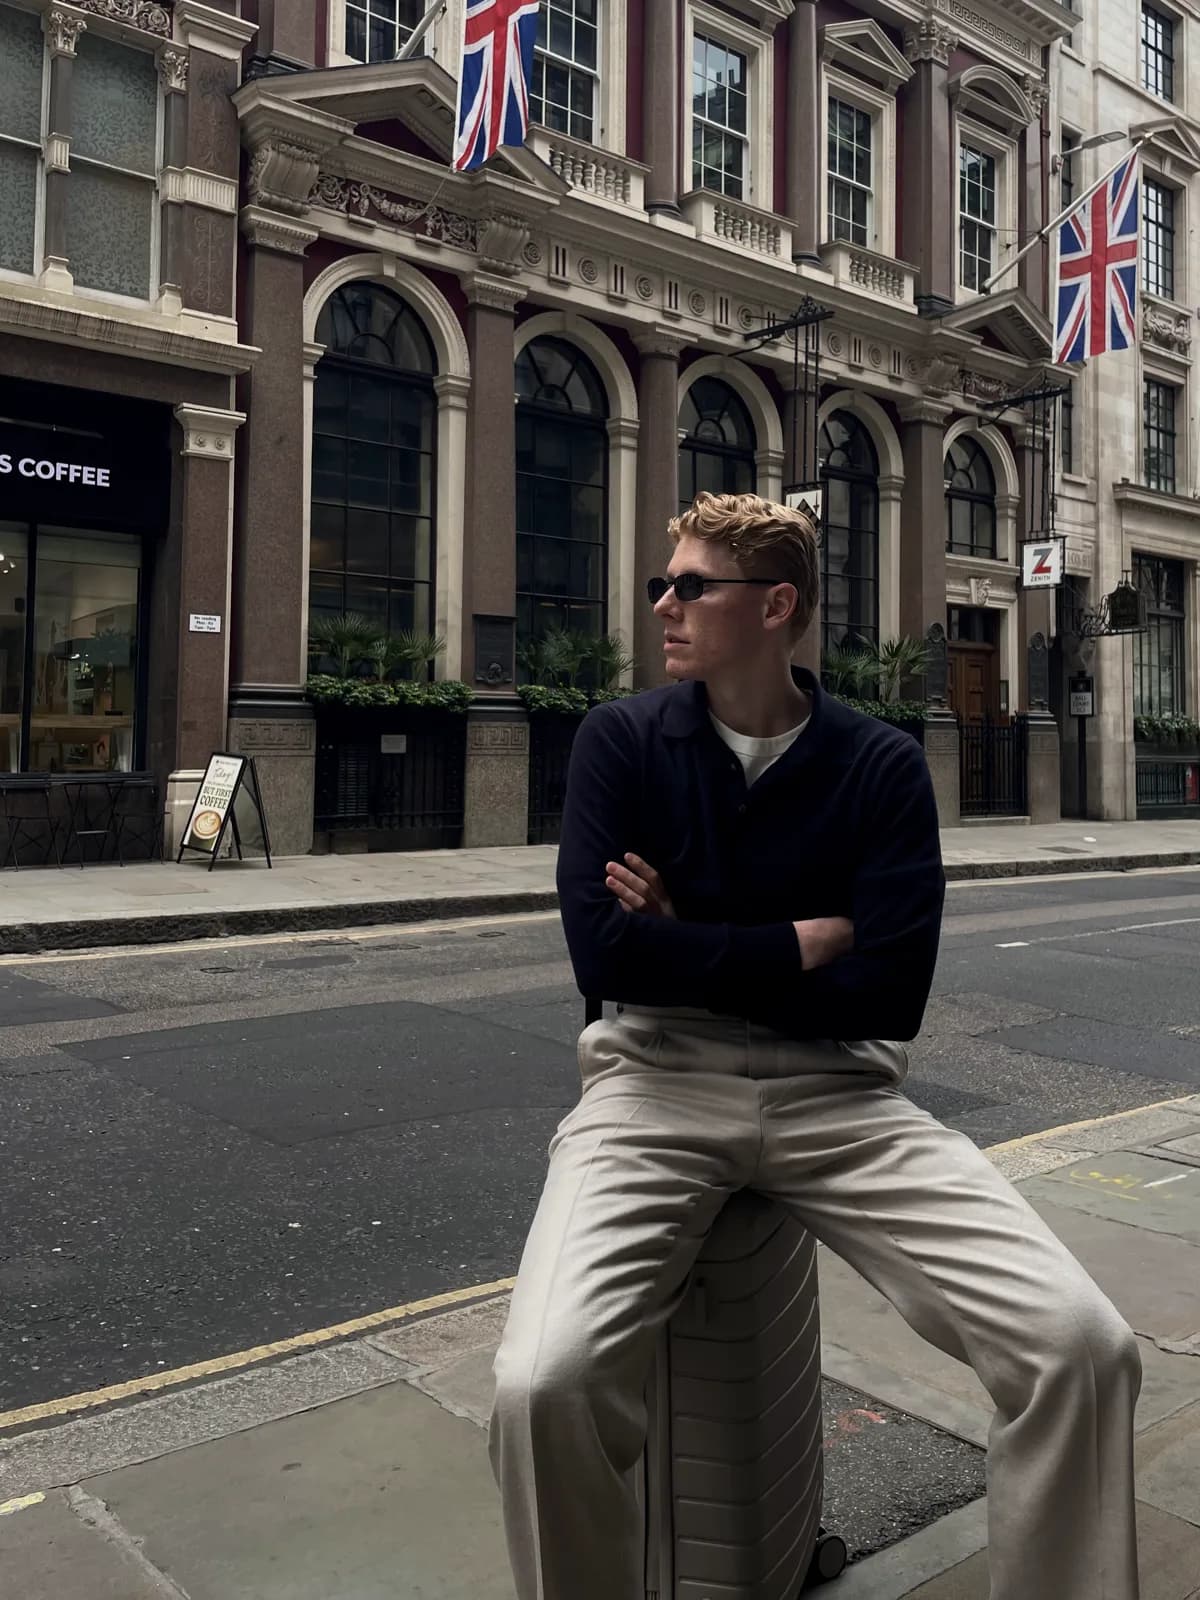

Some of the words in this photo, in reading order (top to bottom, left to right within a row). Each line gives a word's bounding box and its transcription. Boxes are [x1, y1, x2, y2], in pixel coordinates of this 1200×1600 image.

[18, 457, 110, 487] COFFEE
[1032, 548, 1053, 574] Z
[200, 795, 228, 809] COFFEE
[203, 786, 216, 795] BUT
[215, 788, 232, 798] FIRST
